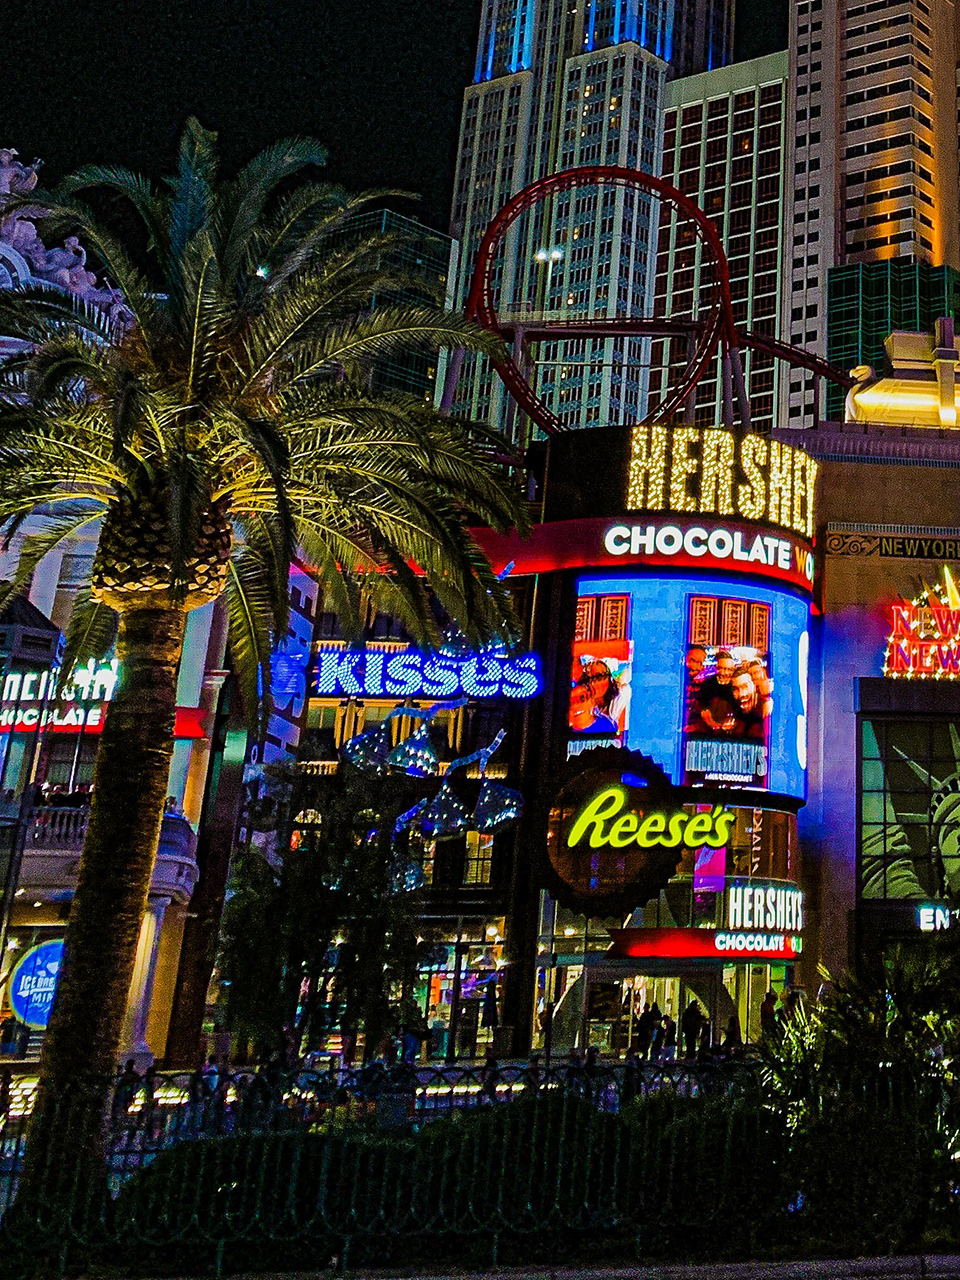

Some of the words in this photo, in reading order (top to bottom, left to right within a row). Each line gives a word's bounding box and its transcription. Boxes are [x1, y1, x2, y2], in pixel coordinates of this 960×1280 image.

[605, 526, 791, 570] CHOCOLATE
[882, 538, 919, 556] NEW
[567, 789, 735, 848] Reese's
[715, 934, 784, 951] CHOCOLATE
